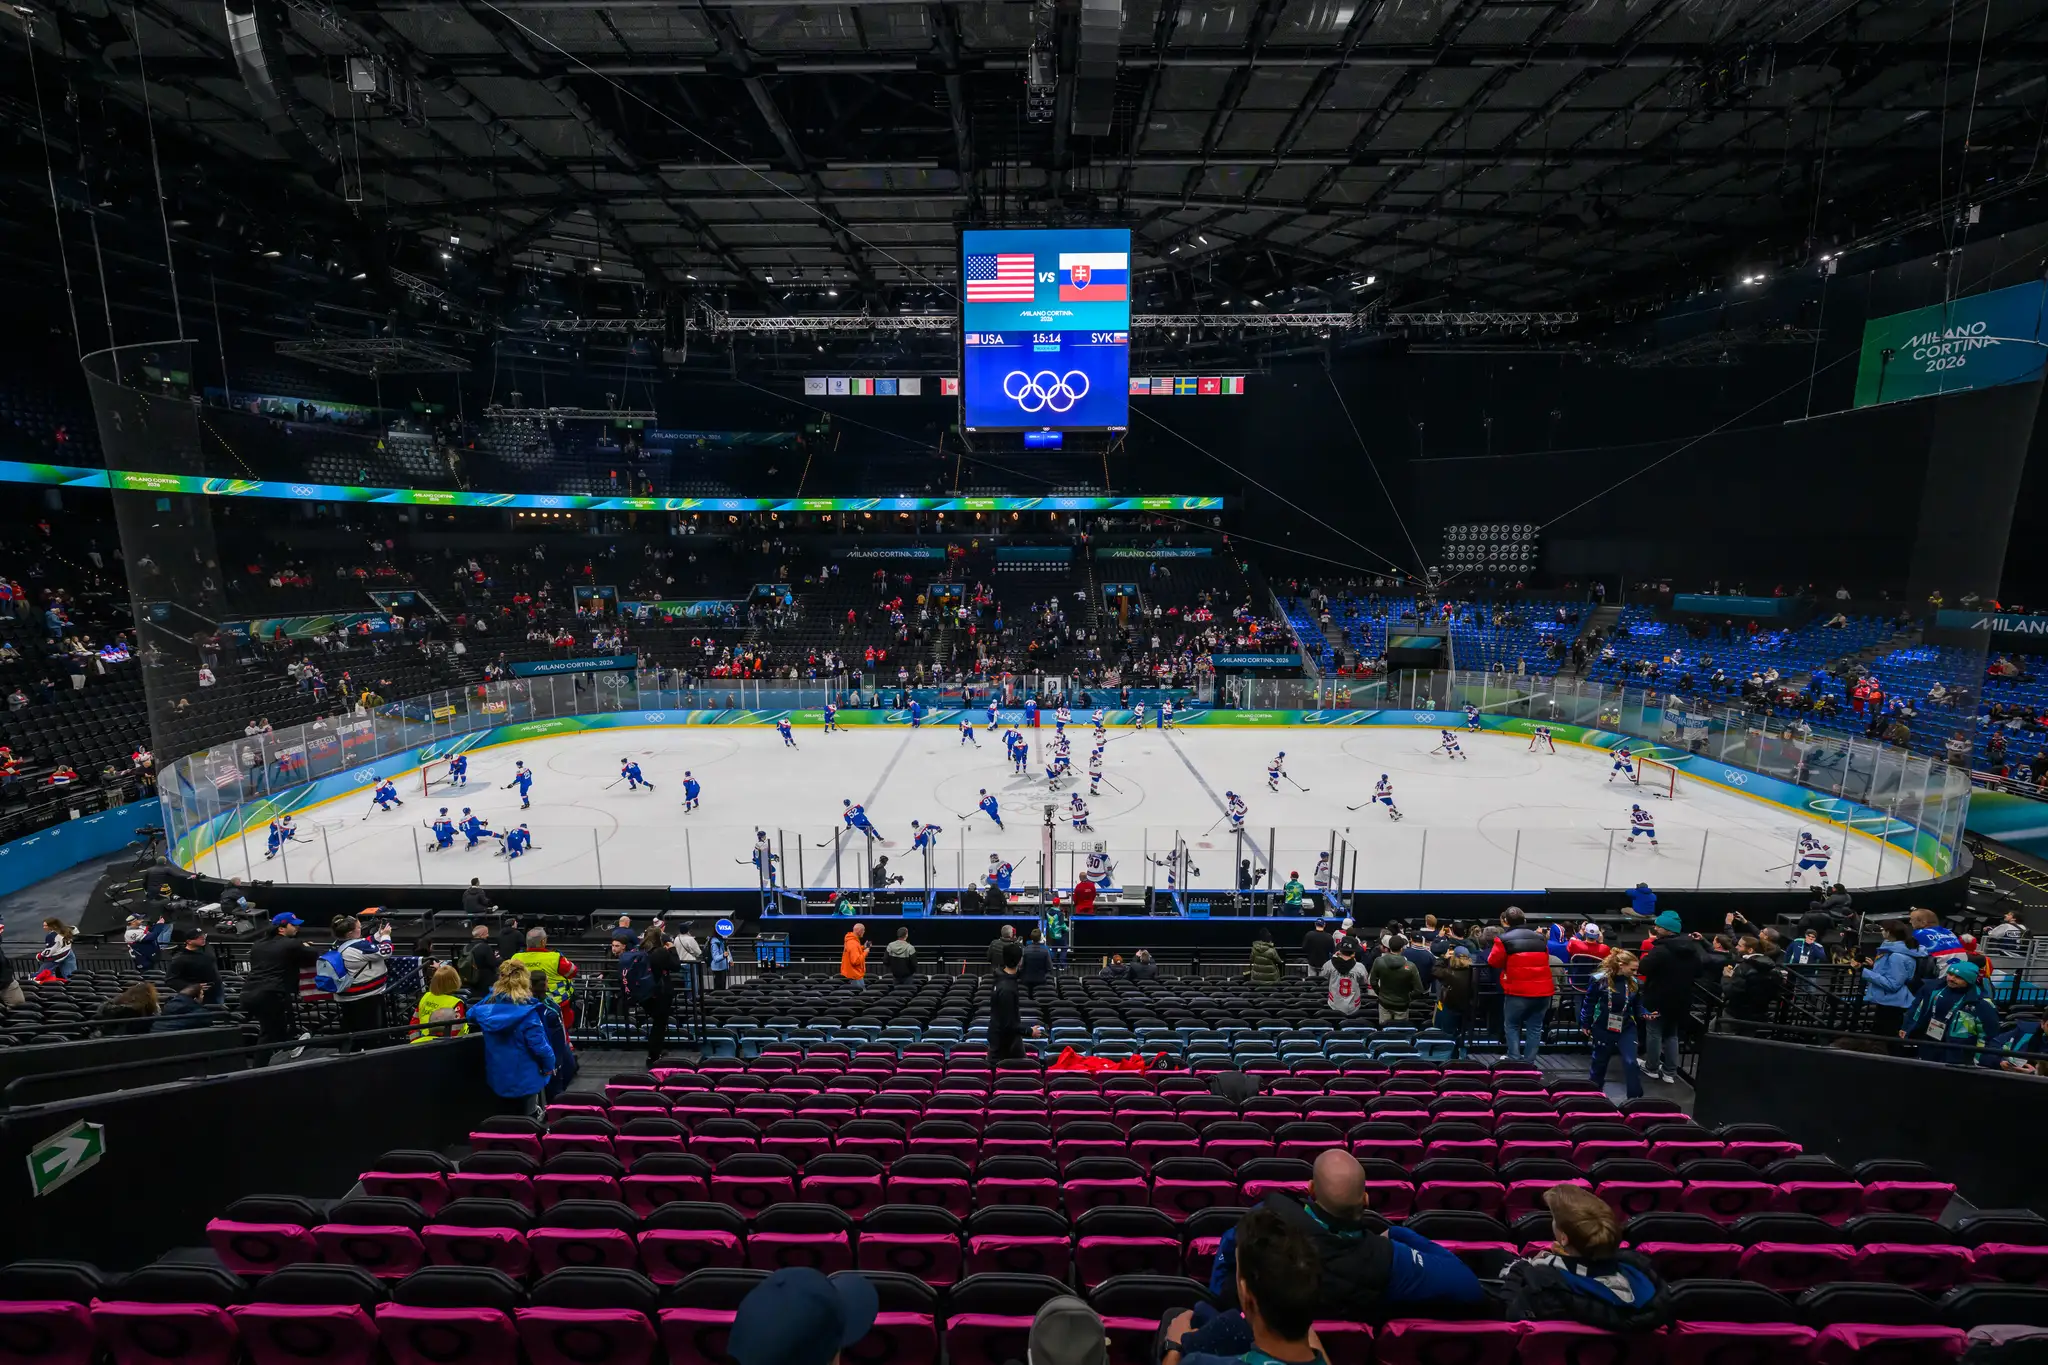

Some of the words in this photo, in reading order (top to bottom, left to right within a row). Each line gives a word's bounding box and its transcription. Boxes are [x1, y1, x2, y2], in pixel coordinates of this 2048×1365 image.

[1038, 272, 1055, 283] VS
[980, 334, 1004, 345] USA
[1033, 333, 1061, 343] 15:14
[1091, 333, 1113, 344] SVK
[1901, 321, 1987, 350] MILANO
[1912, 334, 2001, 361] CORTINA
[1925, 354, 1967, 373] 2026
[651, 432, 679, 440] MILANO
[1112, 550, 1145, 558] MILANO
[1145, 550, 1179, 558] CORTINA
[1971, 617, 2048, 635] MILAN
[534, 662, 564, 671] MILANO
[565, 661, 597, 670] CORTINA
[984, 796, 993, 807] 91
[1073, 802, 1083, 812] 10
[847, 807, 860, 819] 52
[1635, 813, 1648, 823] 86
[461, 822, 471, 831] 21
[1805, 842, 1821, 851] 34
[622, 968, 631, 993] USA
[1339, 978, 1352, 997] 8
